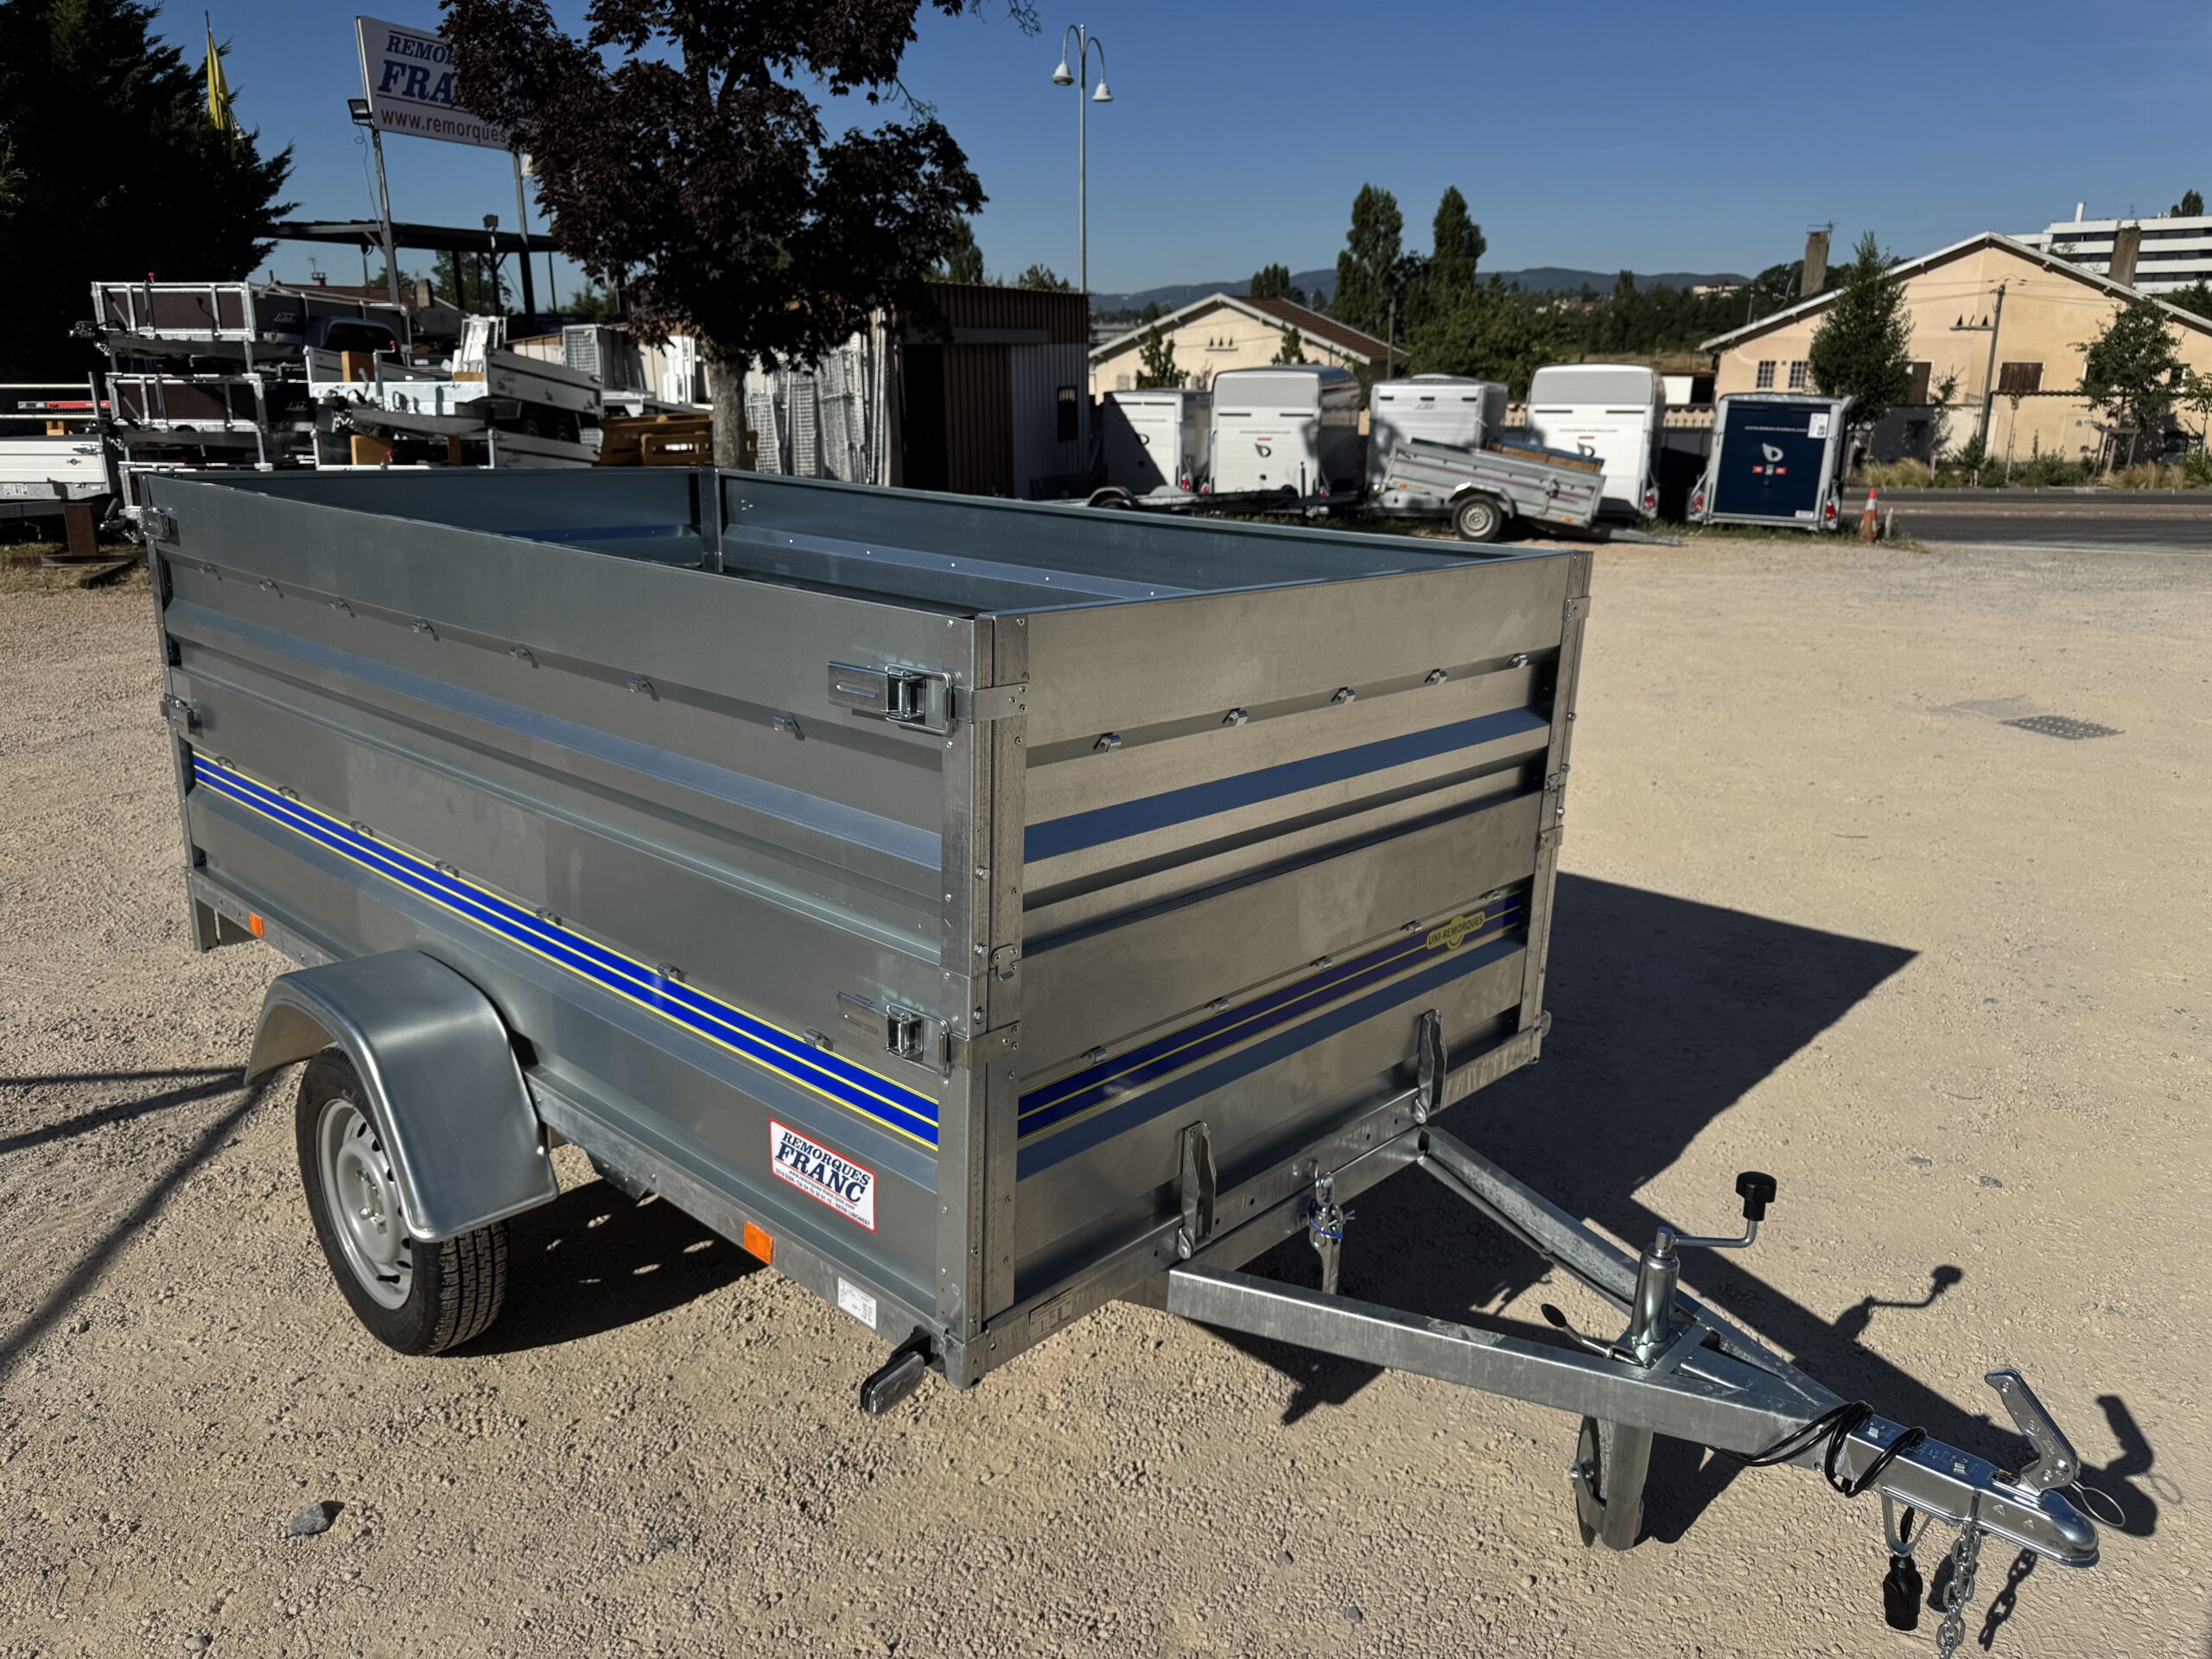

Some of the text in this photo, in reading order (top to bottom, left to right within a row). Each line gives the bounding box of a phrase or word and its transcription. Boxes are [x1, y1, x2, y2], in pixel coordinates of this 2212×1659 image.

[385, 35, 454, 65] REMO
[378, 59, 454, 105] FRA
[1428, 914, 1484, 945] UNI-REMORQUES
[775, 1141, 866, 1203] FRANC
[782, 1131, 871, 1185] REMORQUES
